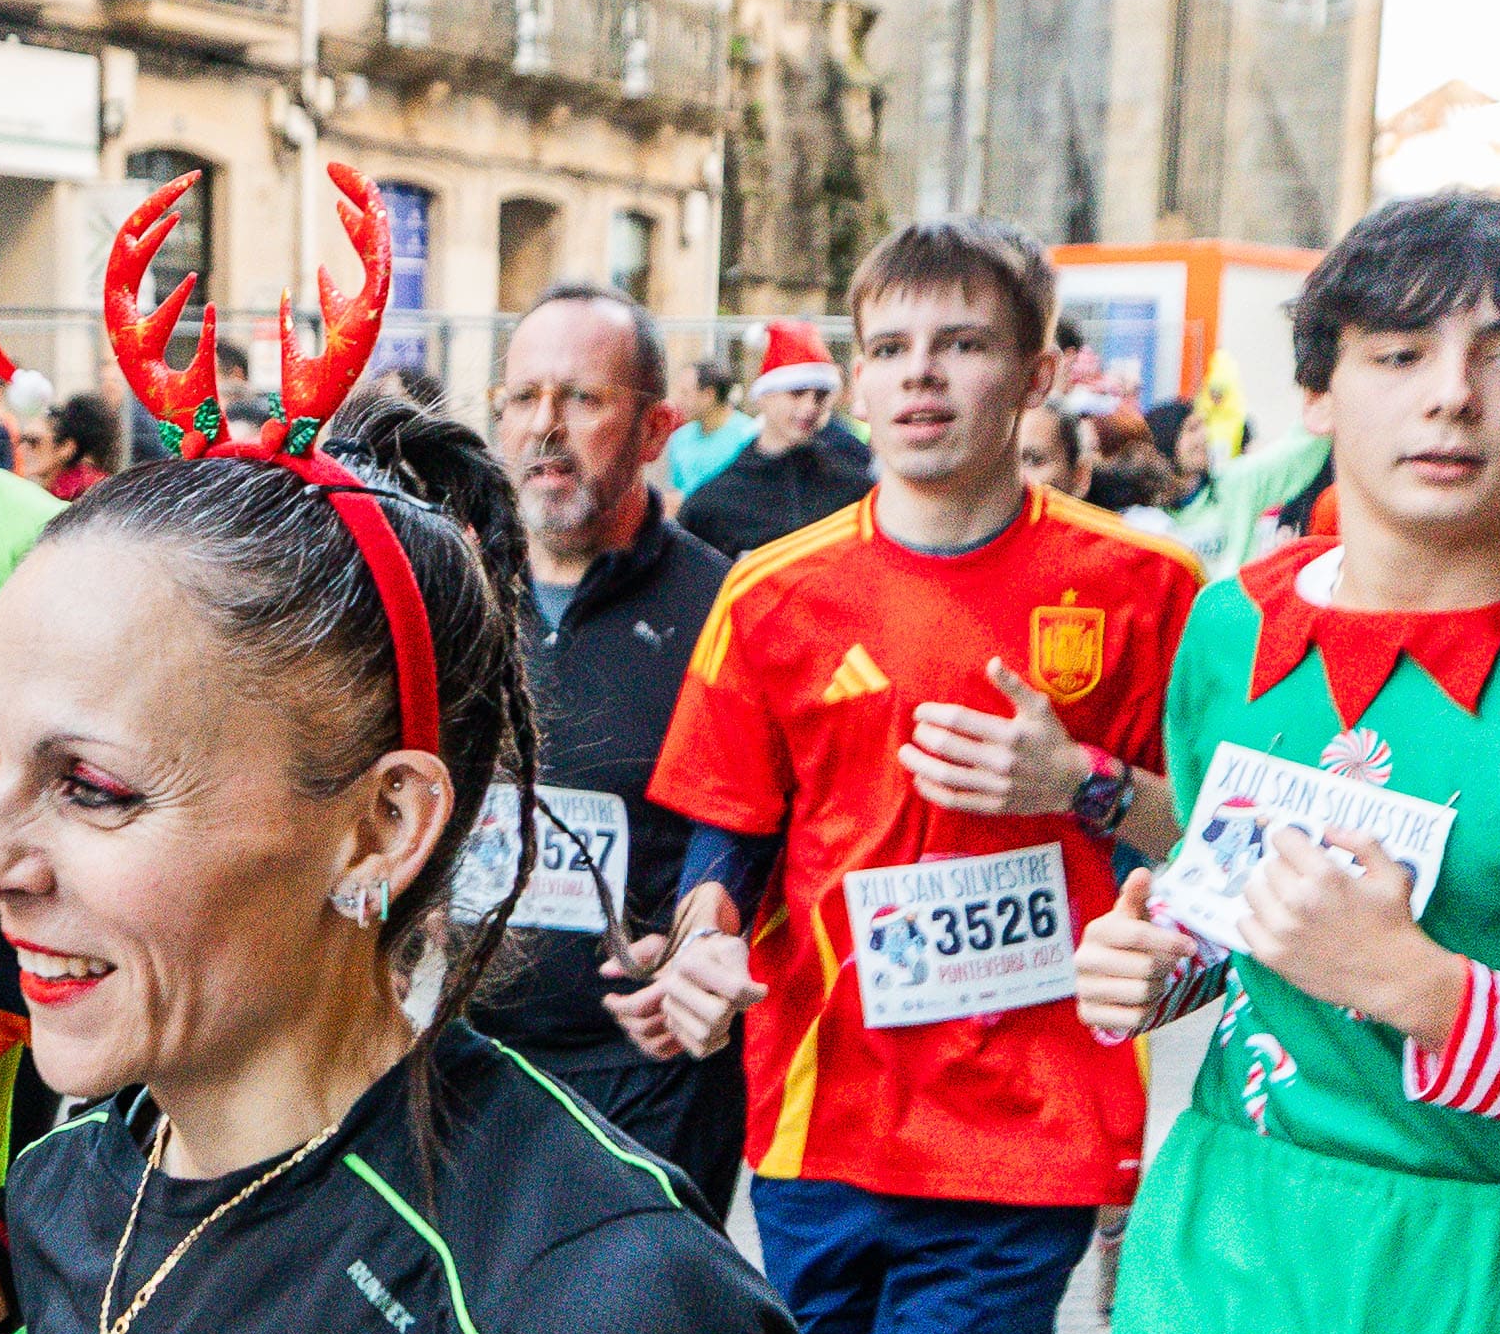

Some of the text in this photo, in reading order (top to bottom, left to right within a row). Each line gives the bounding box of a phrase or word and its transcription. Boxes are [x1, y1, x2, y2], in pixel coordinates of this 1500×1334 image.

[1269, 769, 1320, 816] SAN
[1324, 785, 1440, 853] SILVESTRE
[901, 870, 947, 904] SAN
[950, 851, 1051, 900] SILVESTRE
[931, 886, 1058, 956] 3526
